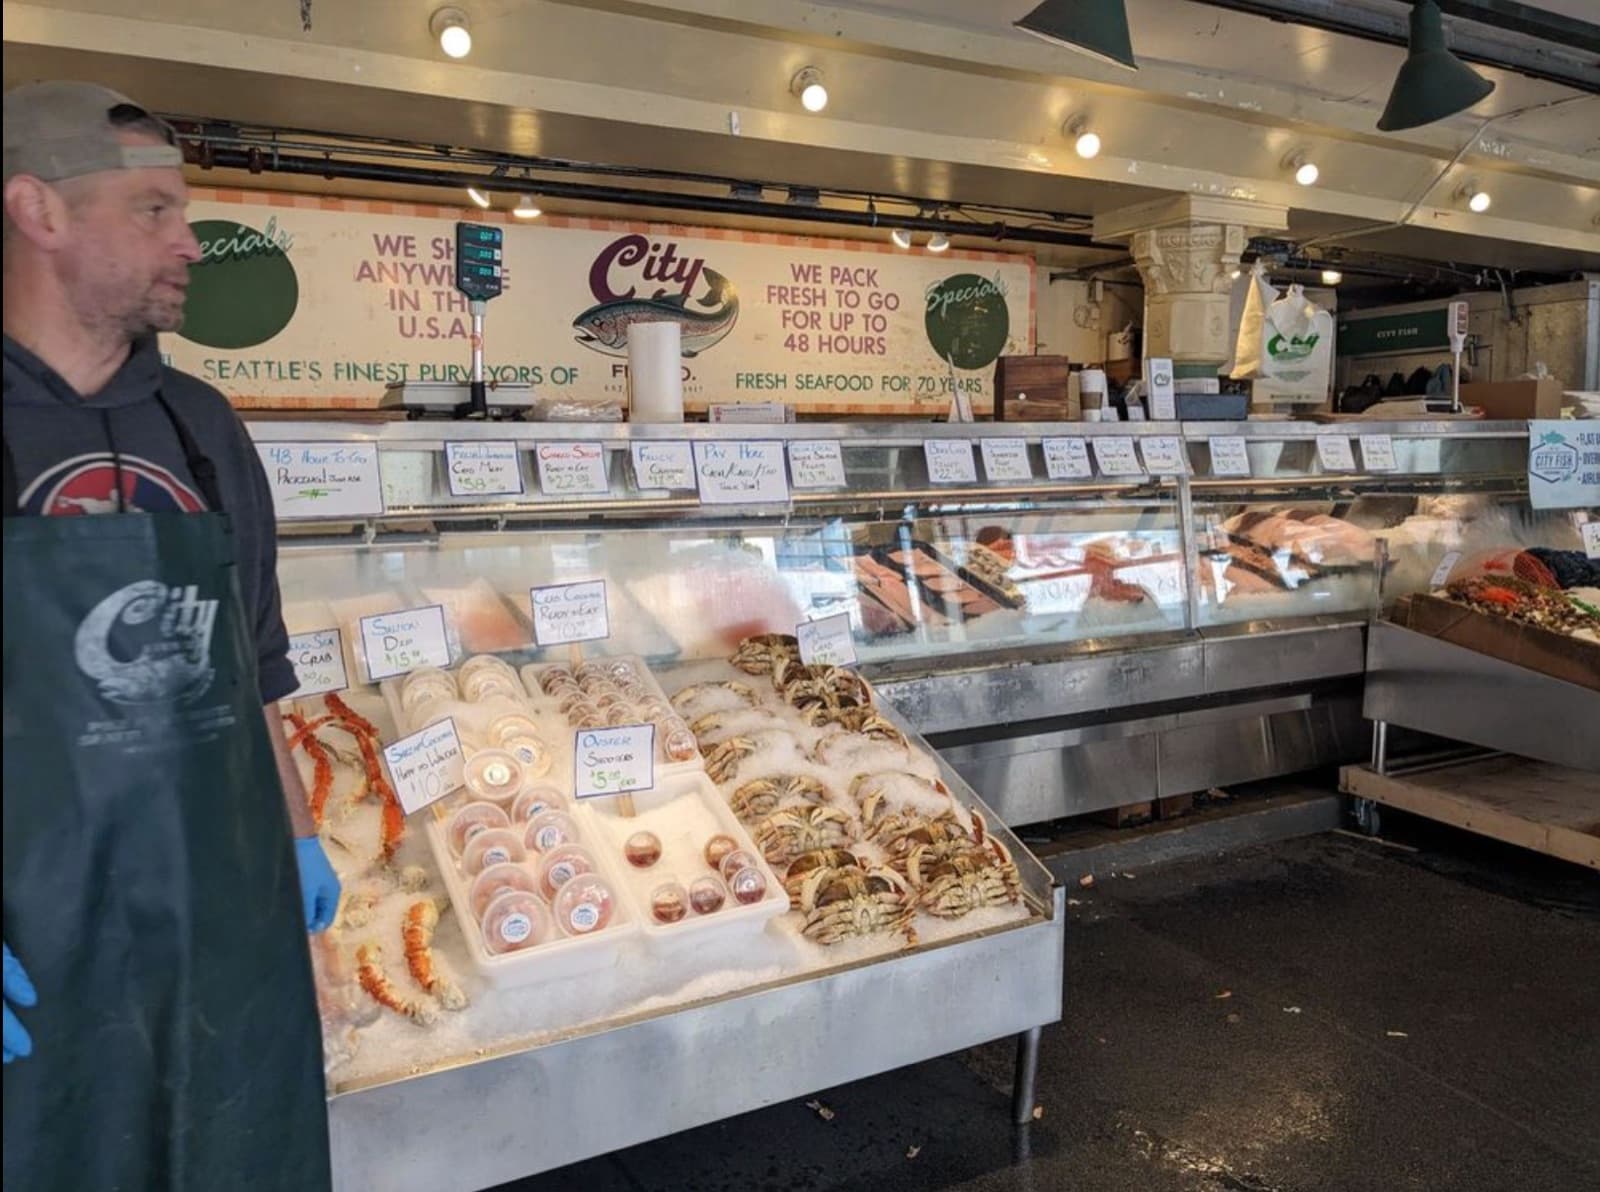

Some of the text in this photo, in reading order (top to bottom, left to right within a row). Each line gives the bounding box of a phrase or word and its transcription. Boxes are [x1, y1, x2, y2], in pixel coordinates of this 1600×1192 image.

[200, 216, 295, 257] ecials
[373, 234, 416, 257] WE
[589, 234, 705, 306] City
[790, 264, 878, 288] WE PACK
[389, 289, 470, 313] IN TH
[767, 286, 900, 312] FRESH TO GO
[925, 269, 1009, 317] Specials
[398, 316, 474, 339] U.S.A.
[781, 309, 888, 333] FOR UP TO
[783, 334, 886, 355] 48 HOURS
[203, 359, 579, 385] SEATTLE'S FINEST PURVYORS OF
[735, 373, 982, 393] FRESH SEAFOOD FOR 70 YEARS
[270, 447, 292, 465] 48
[703, 443, 765, 460] PAY HERE
[1535, 454, 1573, 468] CITY FISH
[75, 579, 219, 683] City
[299, 651, 333, 668] CRAB
[583, 733, 632, 749] OYSTER
